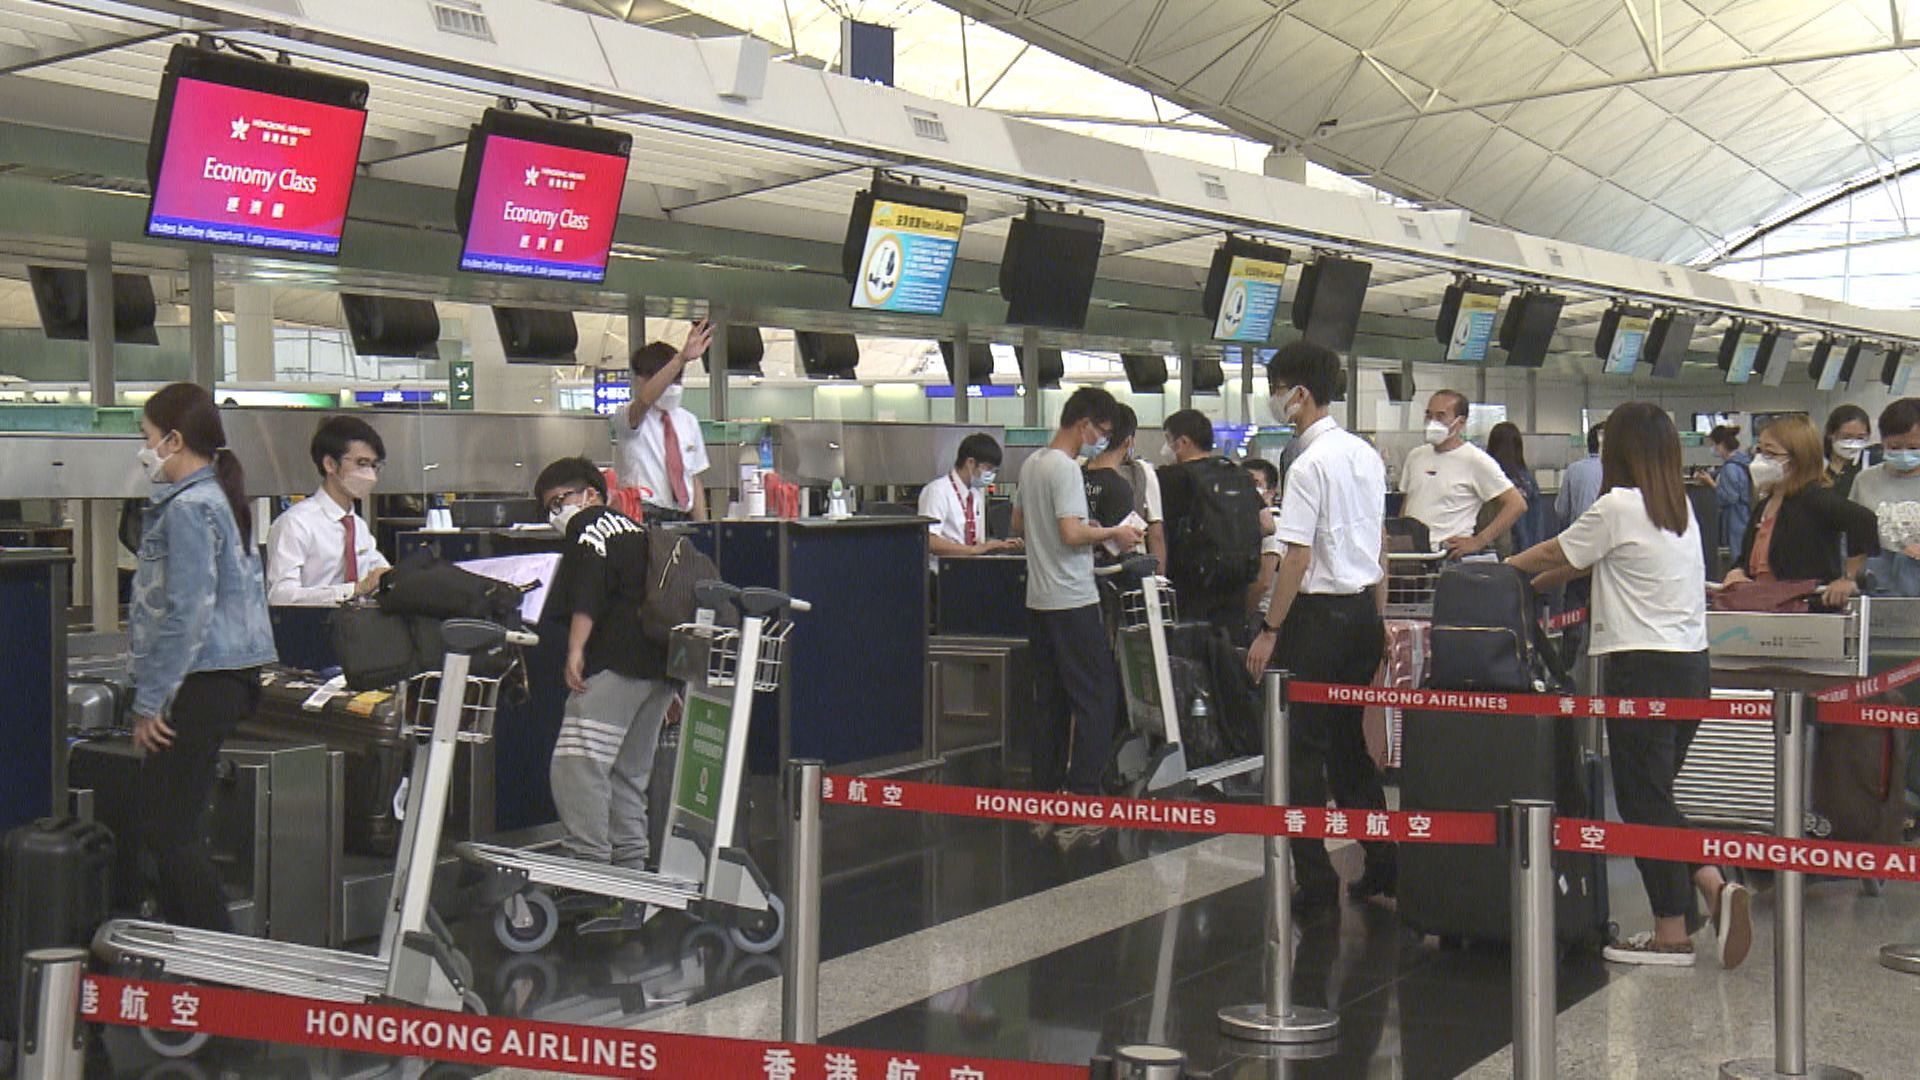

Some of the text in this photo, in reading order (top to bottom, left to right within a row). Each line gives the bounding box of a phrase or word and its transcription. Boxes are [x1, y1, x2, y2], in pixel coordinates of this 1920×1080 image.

[203, 156, 318, 194] Economy Class
[503, 201, 590, 230] Economy Class
[1328, 687, 1508, 710] HONGKONG AIRLINES
[1558, 697, 1666, 716] 香港航空
[1861, 708, 1920, 724] HONG
[976, 794, 1217, 826] HONGKONG AIRLINES
[1284, 808, 1431, 838] 香港航空
[1703, 838, 1876, 871] HONGKONG
[306, 1008, 658, 1071] HONGKONG AIRLINES
